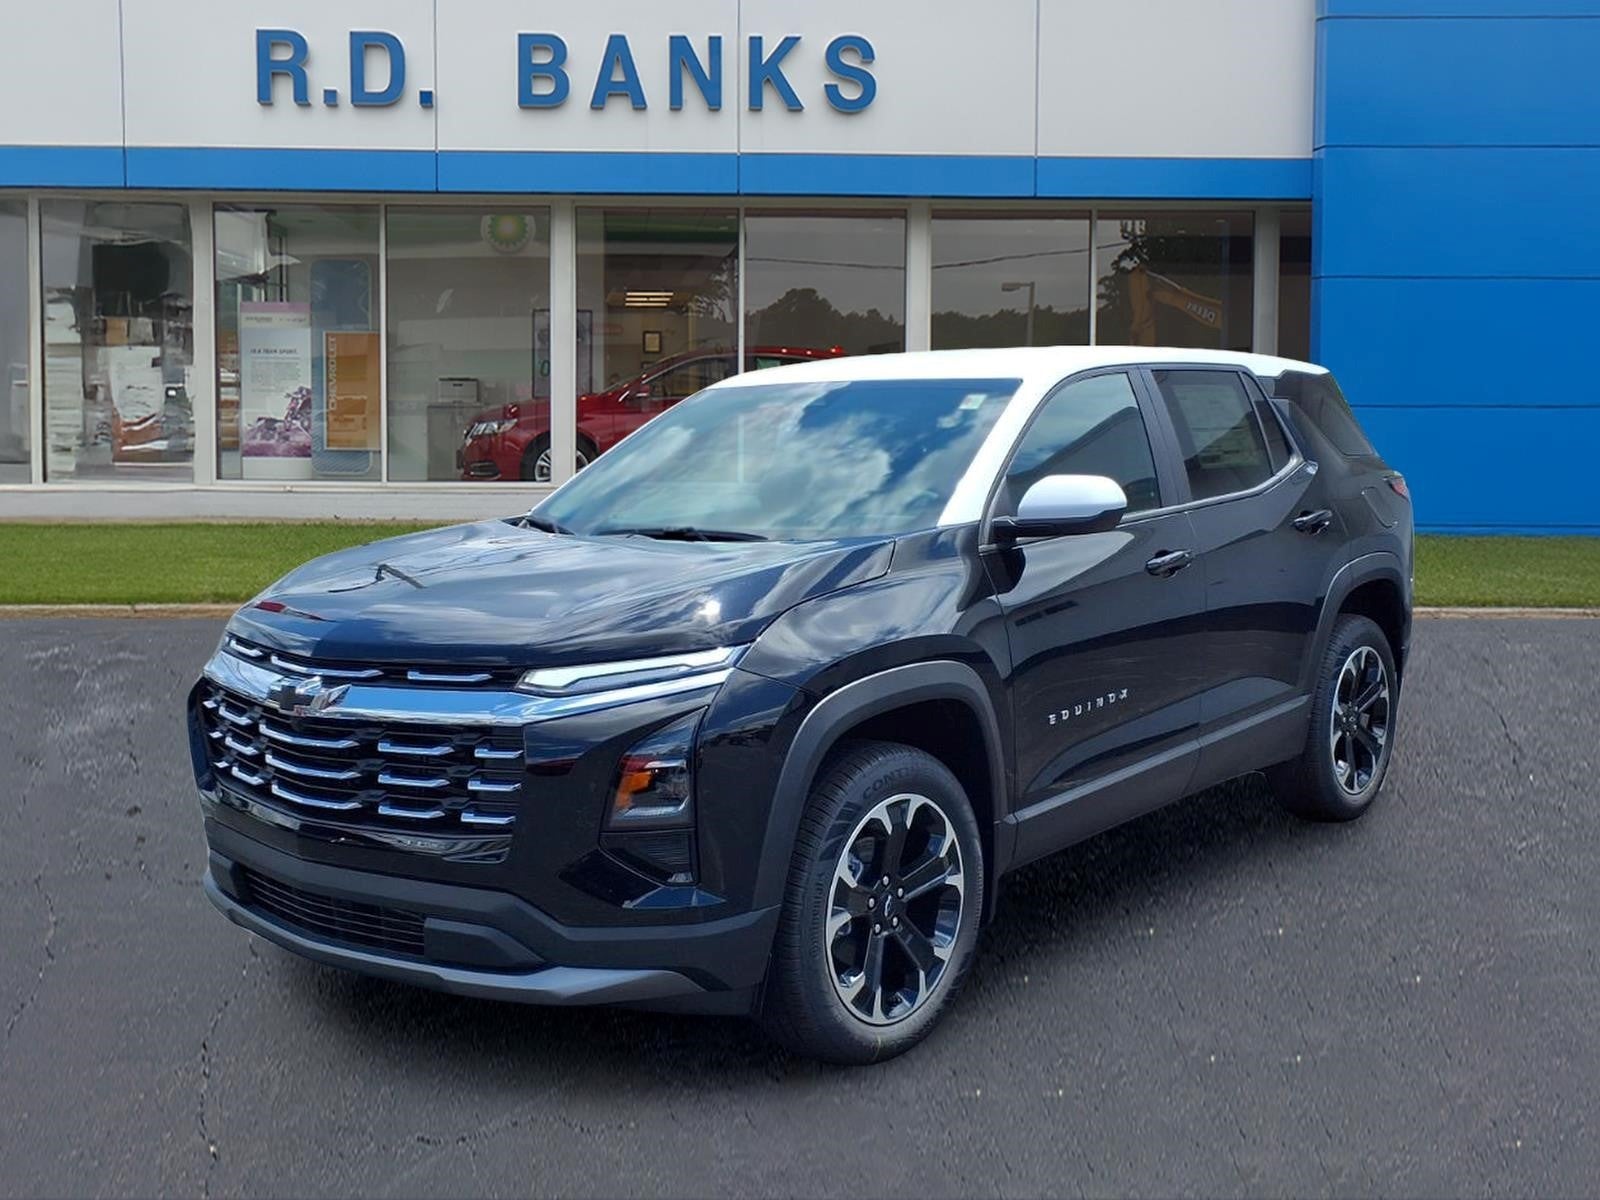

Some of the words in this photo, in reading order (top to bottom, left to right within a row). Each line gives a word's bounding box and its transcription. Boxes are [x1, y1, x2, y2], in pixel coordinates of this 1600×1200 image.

[256, 29, 434, 108] R.D.
[518, 33, 877, 114] BANKS
[328, 335, 337, 411] CHEVROLET
[1048, 688, 1128, 725] EQUINOX
